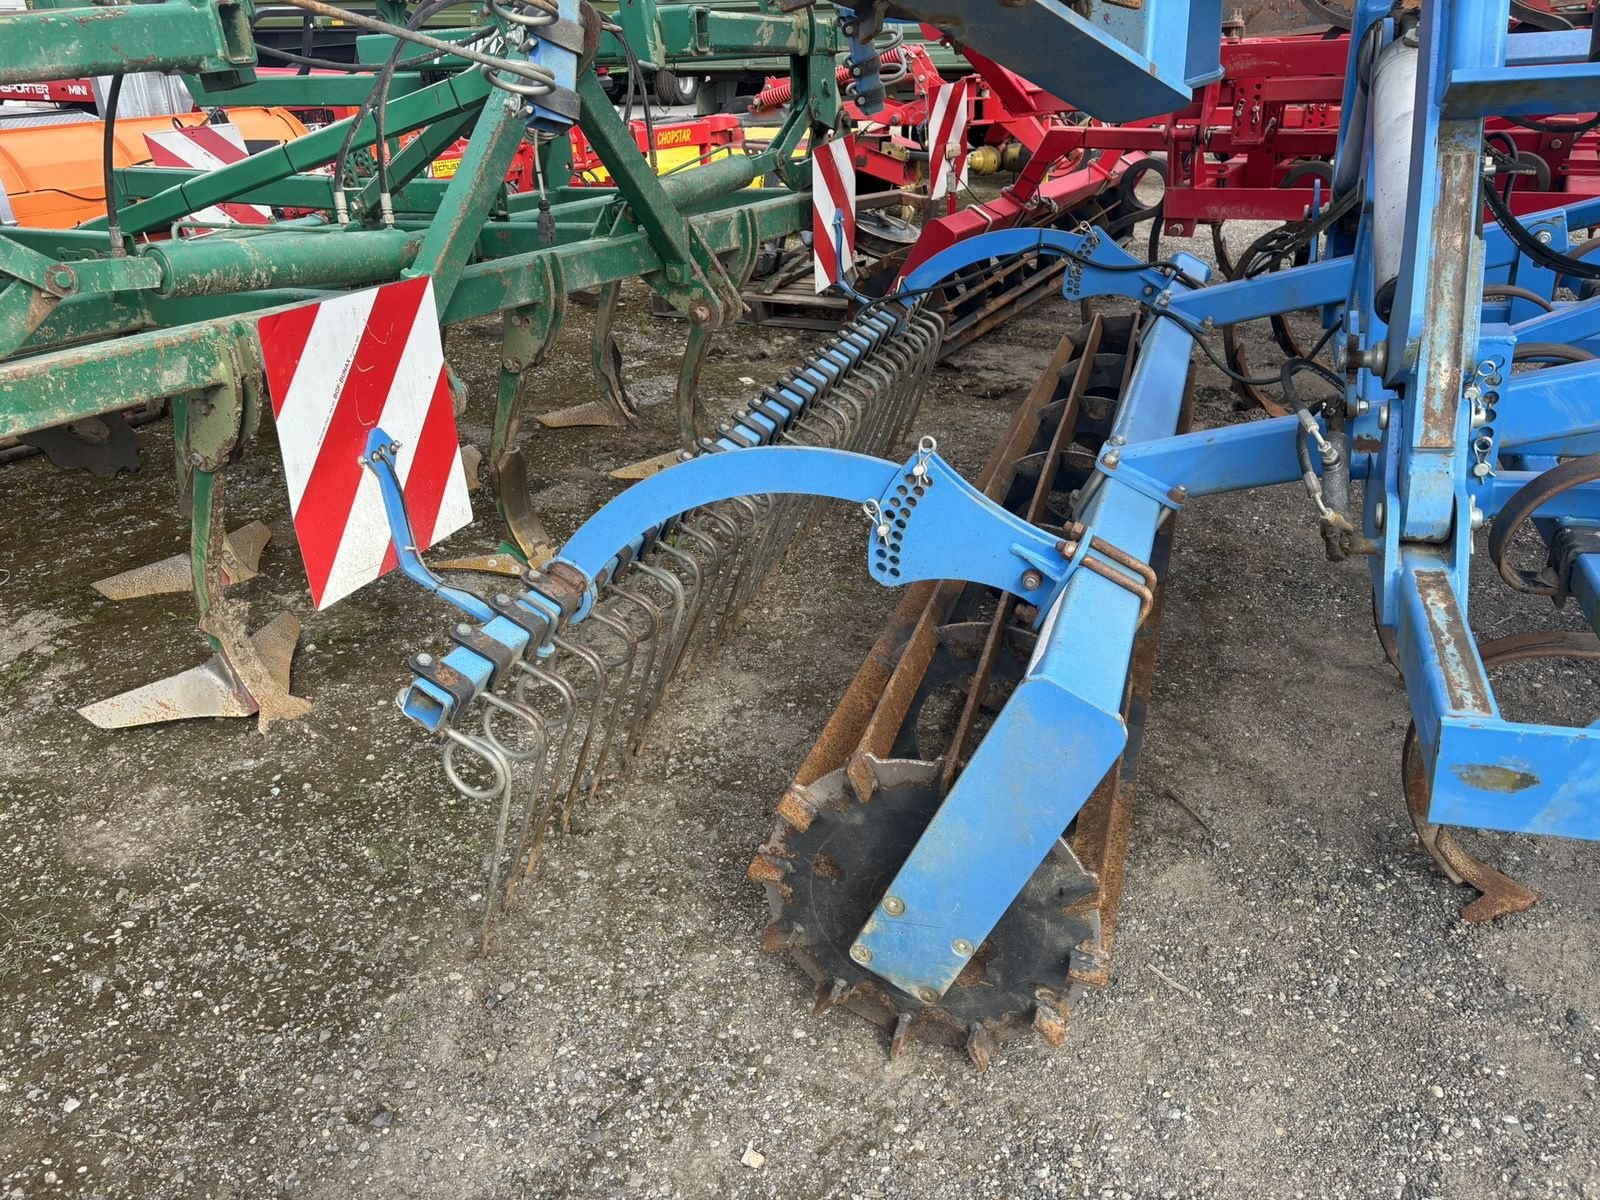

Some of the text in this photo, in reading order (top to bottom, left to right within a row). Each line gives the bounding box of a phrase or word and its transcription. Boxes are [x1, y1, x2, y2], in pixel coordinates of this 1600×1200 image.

[0, 83, 88, 96] SPORTER MINI
[657, 128, 692, 146] CHOPSTAR
[433, 161, 459, 173] SCHUS
